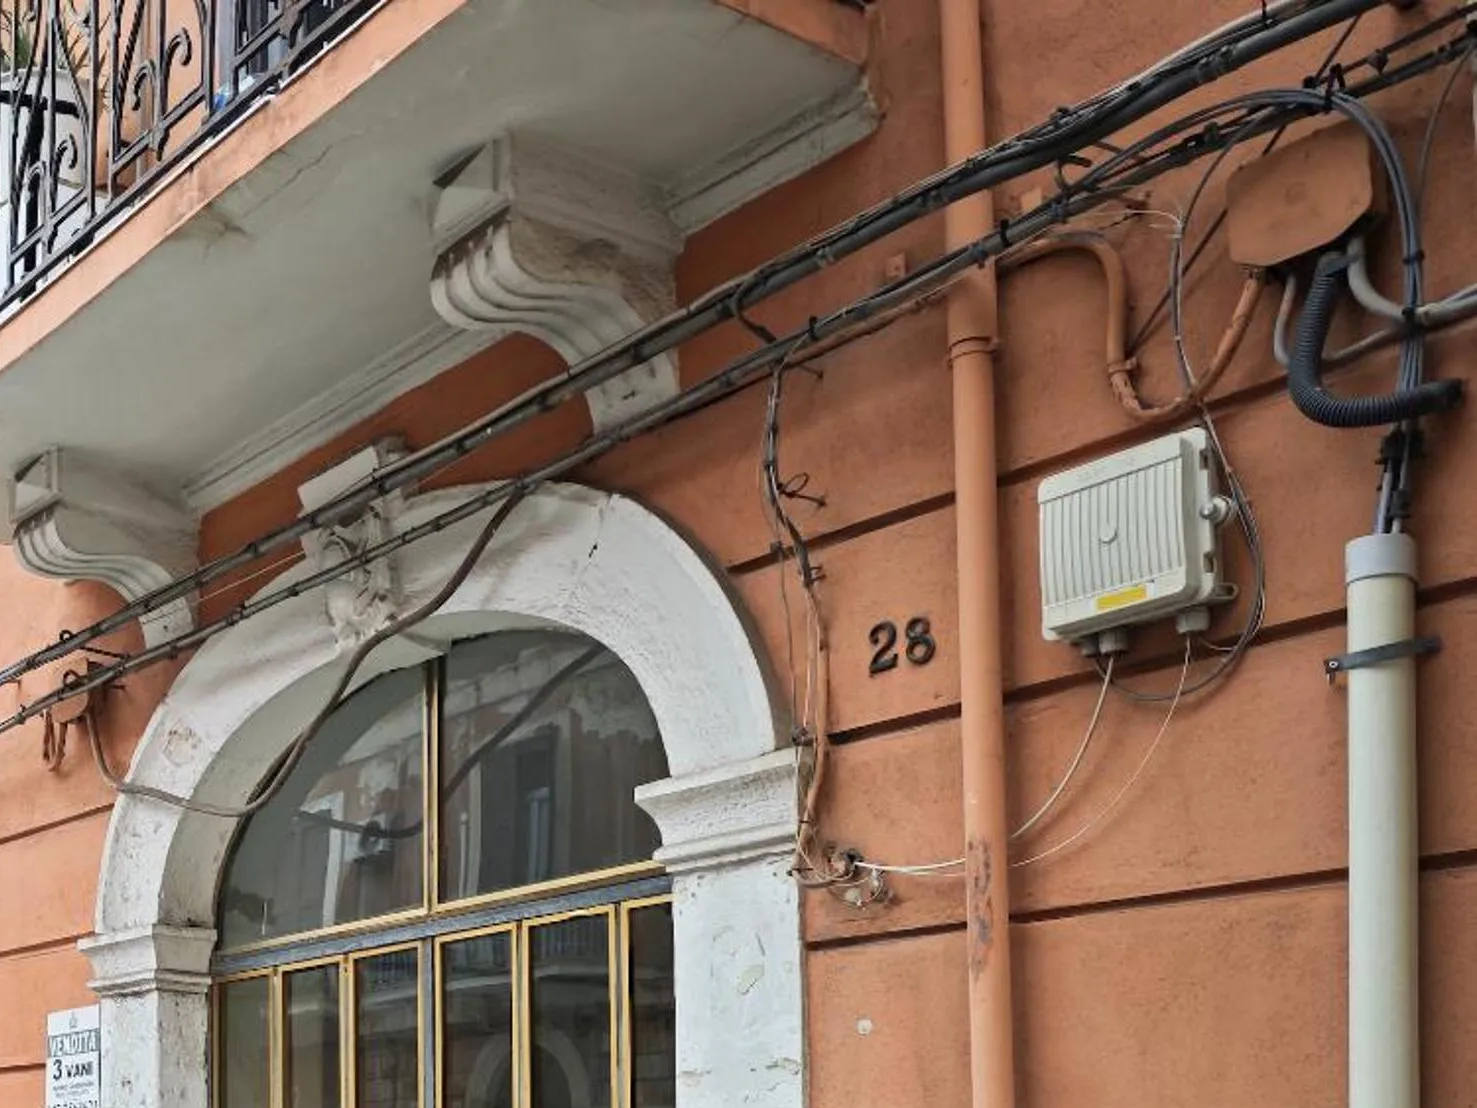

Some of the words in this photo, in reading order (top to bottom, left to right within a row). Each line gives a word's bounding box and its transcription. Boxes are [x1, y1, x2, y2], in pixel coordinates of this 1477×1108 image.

[868, 617, 936, 676] 28
[52, 1059, 63, 1081] 3
[64, 1060, 95, 1079] VANI
